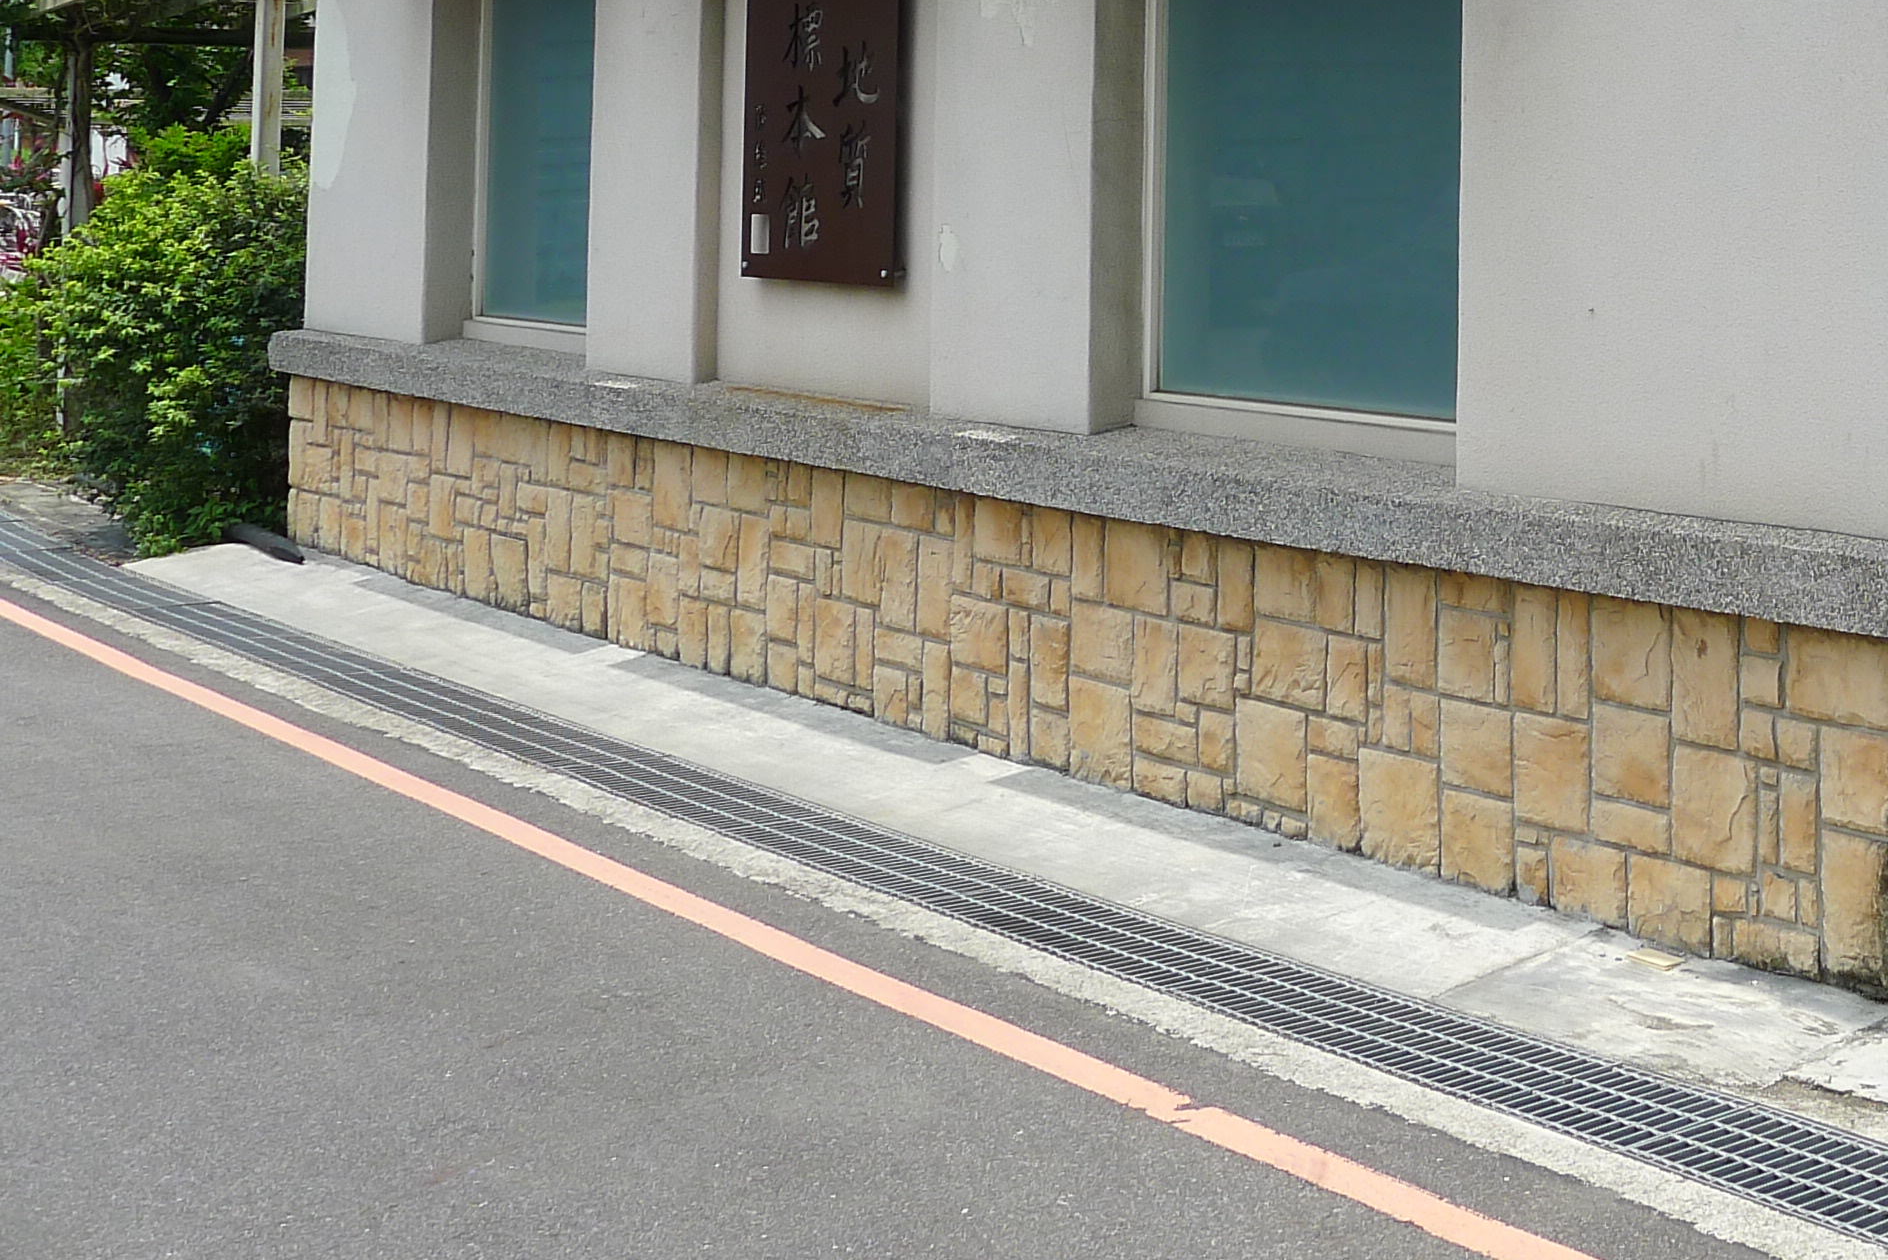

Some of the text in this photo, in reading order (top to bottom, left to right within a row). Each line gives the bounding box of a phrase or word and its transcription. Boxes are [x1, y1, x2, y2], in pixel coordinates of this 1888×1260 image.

[780, 1, 827, 252] 標本館
[832, 38, 880, 209] 地質
